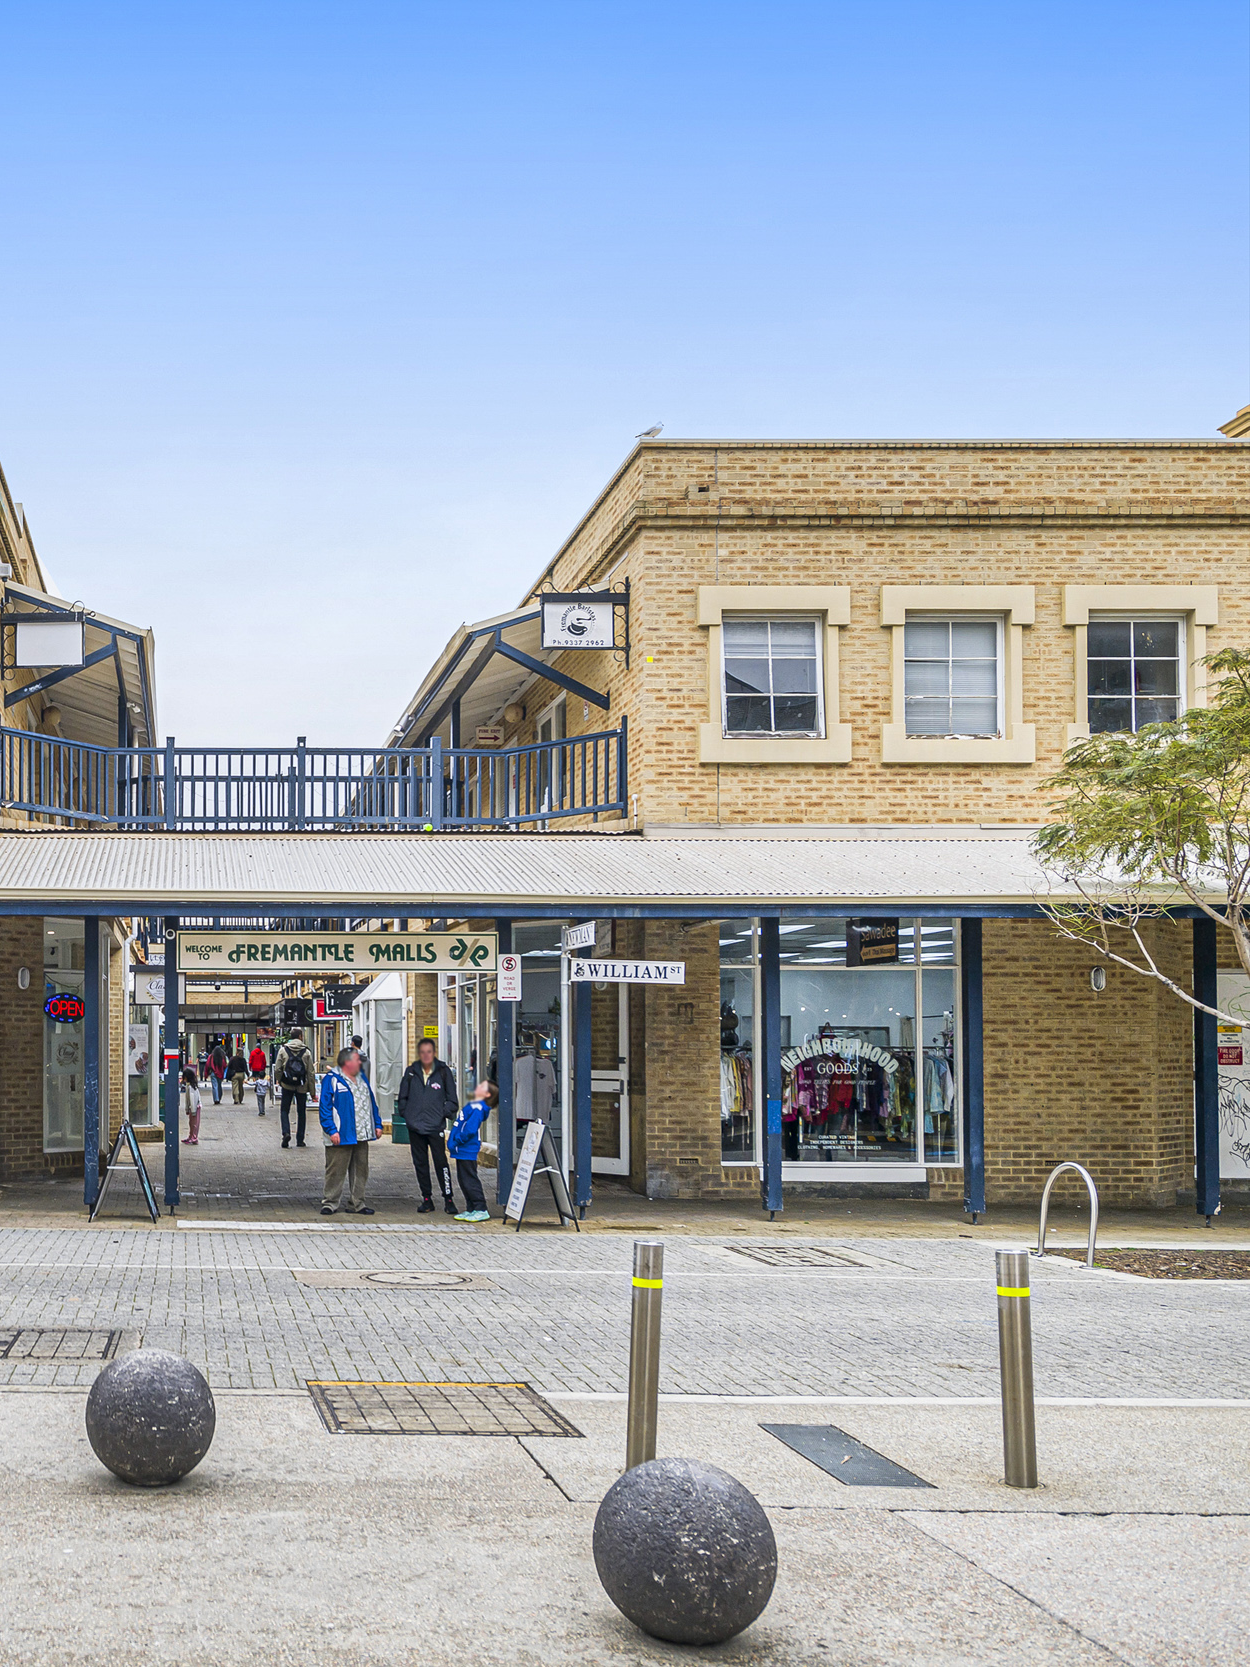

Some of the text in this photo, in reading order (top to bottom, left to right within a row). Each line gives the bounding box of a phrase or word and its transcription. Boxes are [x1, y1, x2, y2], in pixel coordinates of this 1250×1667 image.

[861, 922, 896, 942] Sawadee
[185, 945, 223, 953] WELCOME
[198, 953, 210, 961] TO
[227, 943, 437, 963] FREMANTLE MALLS
[587, 963, 682, 979] WILLIAM ST
[49, 1000, 85, 1017] OPEN
[780, 1037, 899, 1073] NEIGHBOURHOOD
[817, 1062, 859, 1075] GOODS
